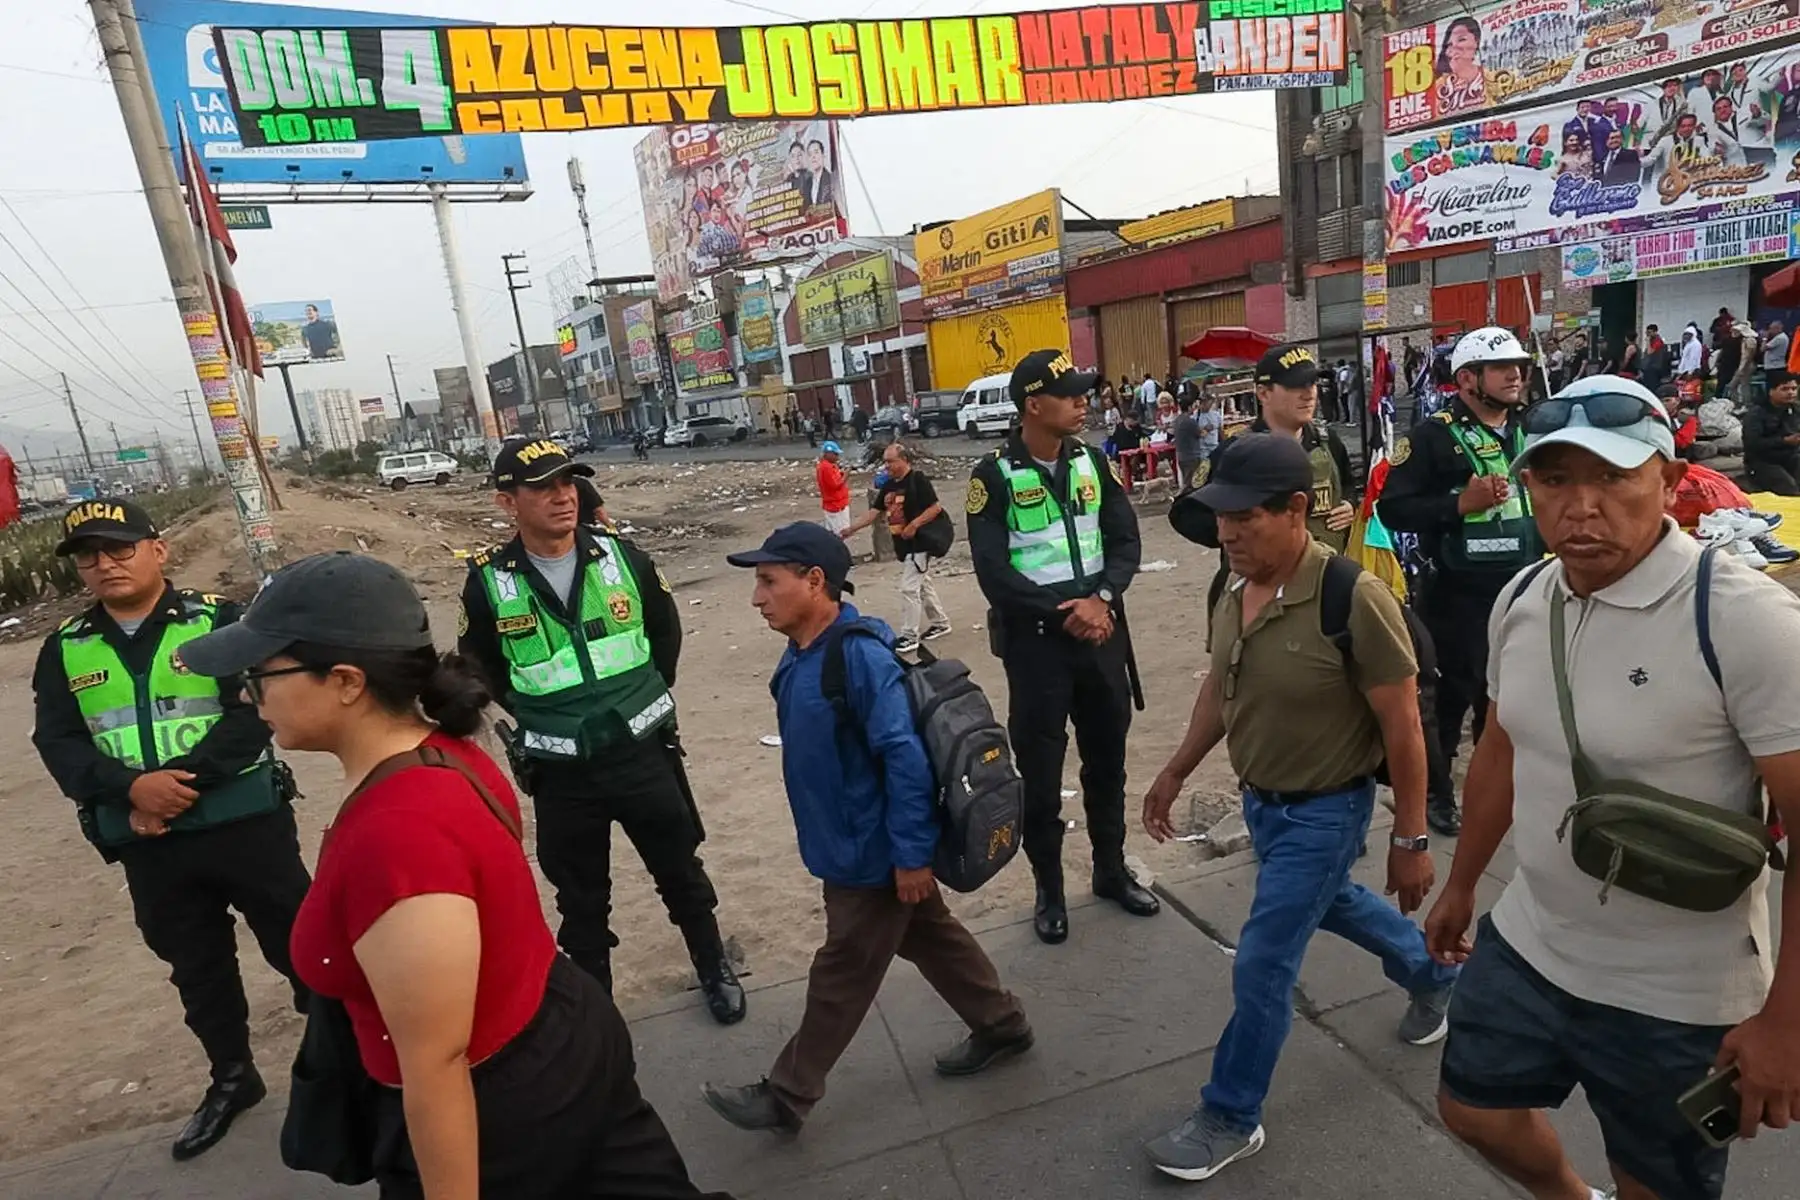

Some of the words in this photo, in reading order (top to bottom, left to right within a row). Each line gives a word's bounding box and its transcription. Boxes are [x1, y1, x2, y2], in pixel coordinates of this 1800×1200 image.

[1491, 2, 1568, 31] ANIVERSARIO
[1711, 4, 1789, 33] CERVEZA
[1018, 3, 1199, 70] NATALY
[1388, 28, 1431, 51] DOM.
[447, 27, 725, 94] AZUCENA
[724, 16, 1026, 118] JOSIMAR
[1589, 40, 1659, 65] GENERAL
[1625, 49, 1678, 71] SOLES
[221, 28, 377, 110] DOM.
[380, 29, 453, 131] 4
[1024, 58, 1198, 105] RAMIREZ
[1385, 45, 1434, 97] 18
[192, 92, 226, 113] LA
[456, 89, 717, 134] CALVAY
[1389, 94, 1431, 118] ENE.
[257, 113, 311, 143] 10
[312, 117, 357, 141] AM
[1388, 113, 1432, 128] 2026
[671, 123, 709, 148] 05
[1428, 176, 1532, 216] Huaralino
[1767, 200, 1794, 211] CRUZ
[222, 210, 265, 225] ANELVÍA
[986, 221, 1028, 250] Giti
[1495, 240, 1512, 251] 18
[1515, 235, 1550, 248] ENE
[66, 503, 126, 533] POLICIA
